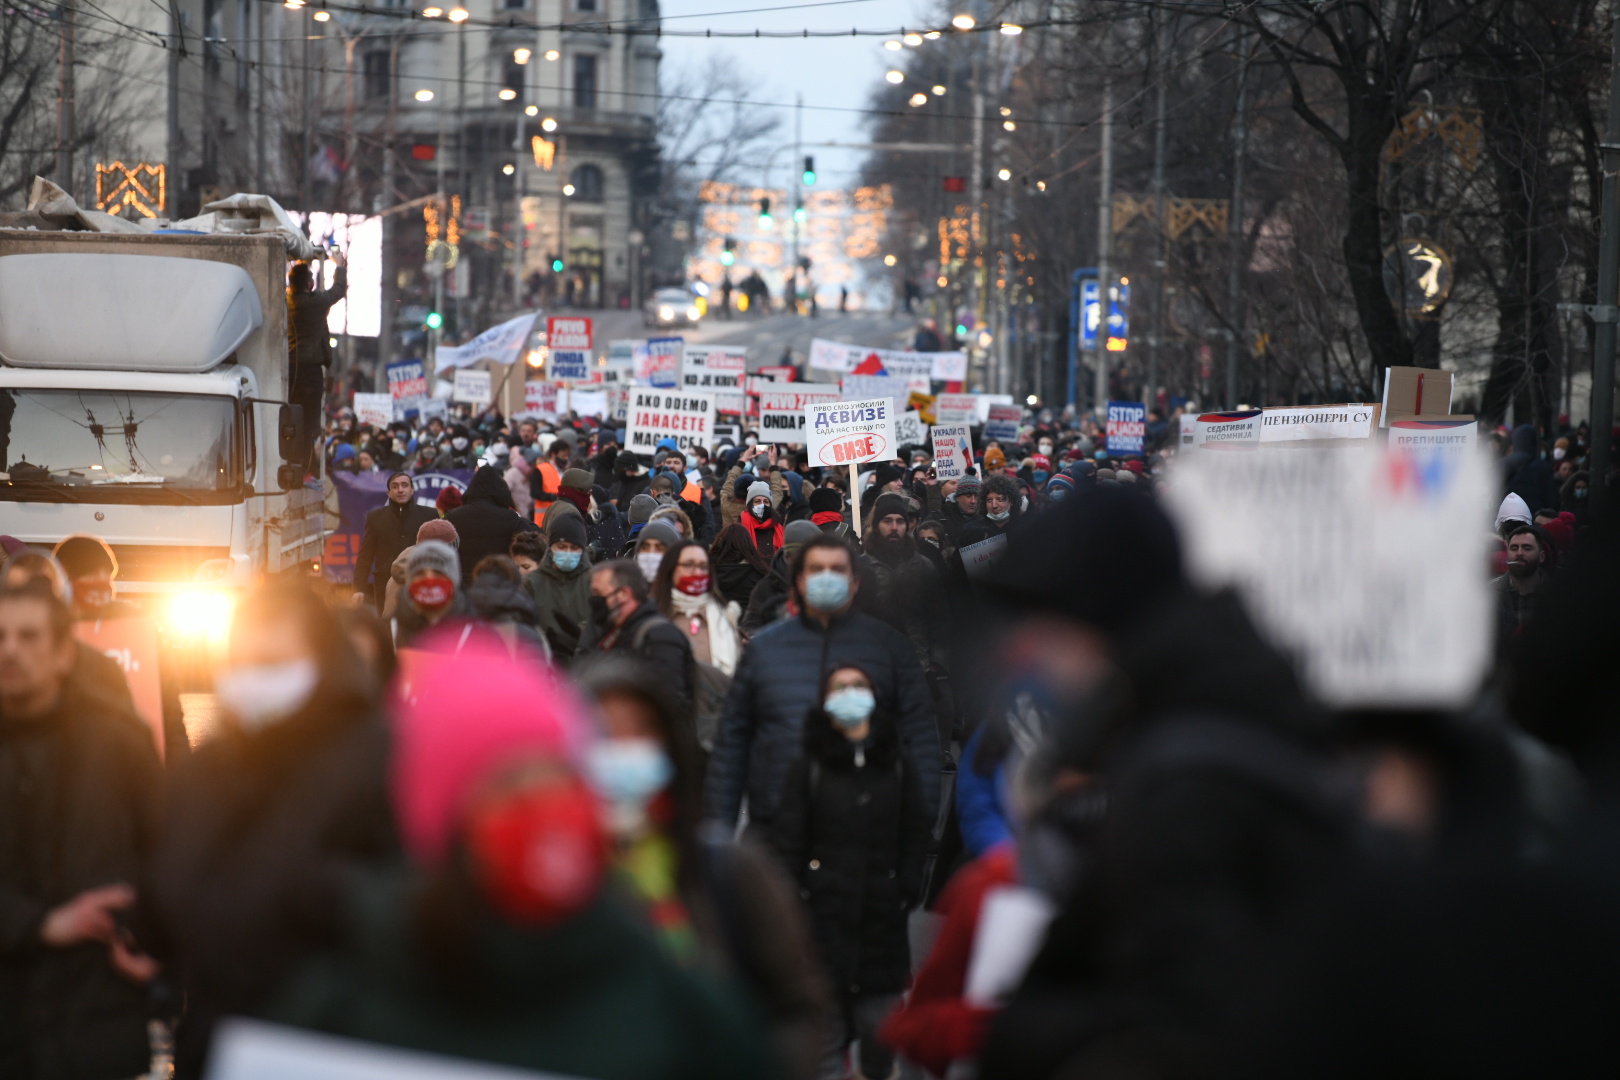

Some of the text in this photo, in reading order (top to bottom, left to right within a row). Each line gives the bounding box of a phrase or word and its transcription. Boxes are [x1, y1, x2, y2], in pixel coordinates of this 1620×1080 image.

[554, 352, 584, 364] ONDA
[387, 363, 422, 382] STOP
[551, 366, 587, 378] POREZ
[684, 374, 698, 385] KO
[700, 374, 711, 386] JE
[636, 394, 660, 408] AKO
[665, 397, 708, 412] ODEMO
[762, 394, 797, 409] PRVO
[850, 400, 885, 410] УНОСИЛИ
[1109, 406, 1143, 422] STOP
[1263, 412, 1371, 426] ПЕНЗИОНЕРИ СУ
[763, 415, 796, 430] ONDA
[852, 424, 874, 432] ТЕРАЈУ
[957, 427, 966, 435] СТЕ
[1206, 424, 1245, 434] СЕДАТИВИ
[1206, 431, 1252, 441] ИНСОМНИЈА
[1397, 435, 1468, 445] ПРЕПИШИТЕ
[935, 438, 956, 448] НАШОЈ
[832, 436, 876, 463] ВИЗЕ
[936, 449, 954, 459] ДЕЦИ
[937, 459, 954, 469] ДЕДА
[938, 469, 960, 478] МРАЗА!
